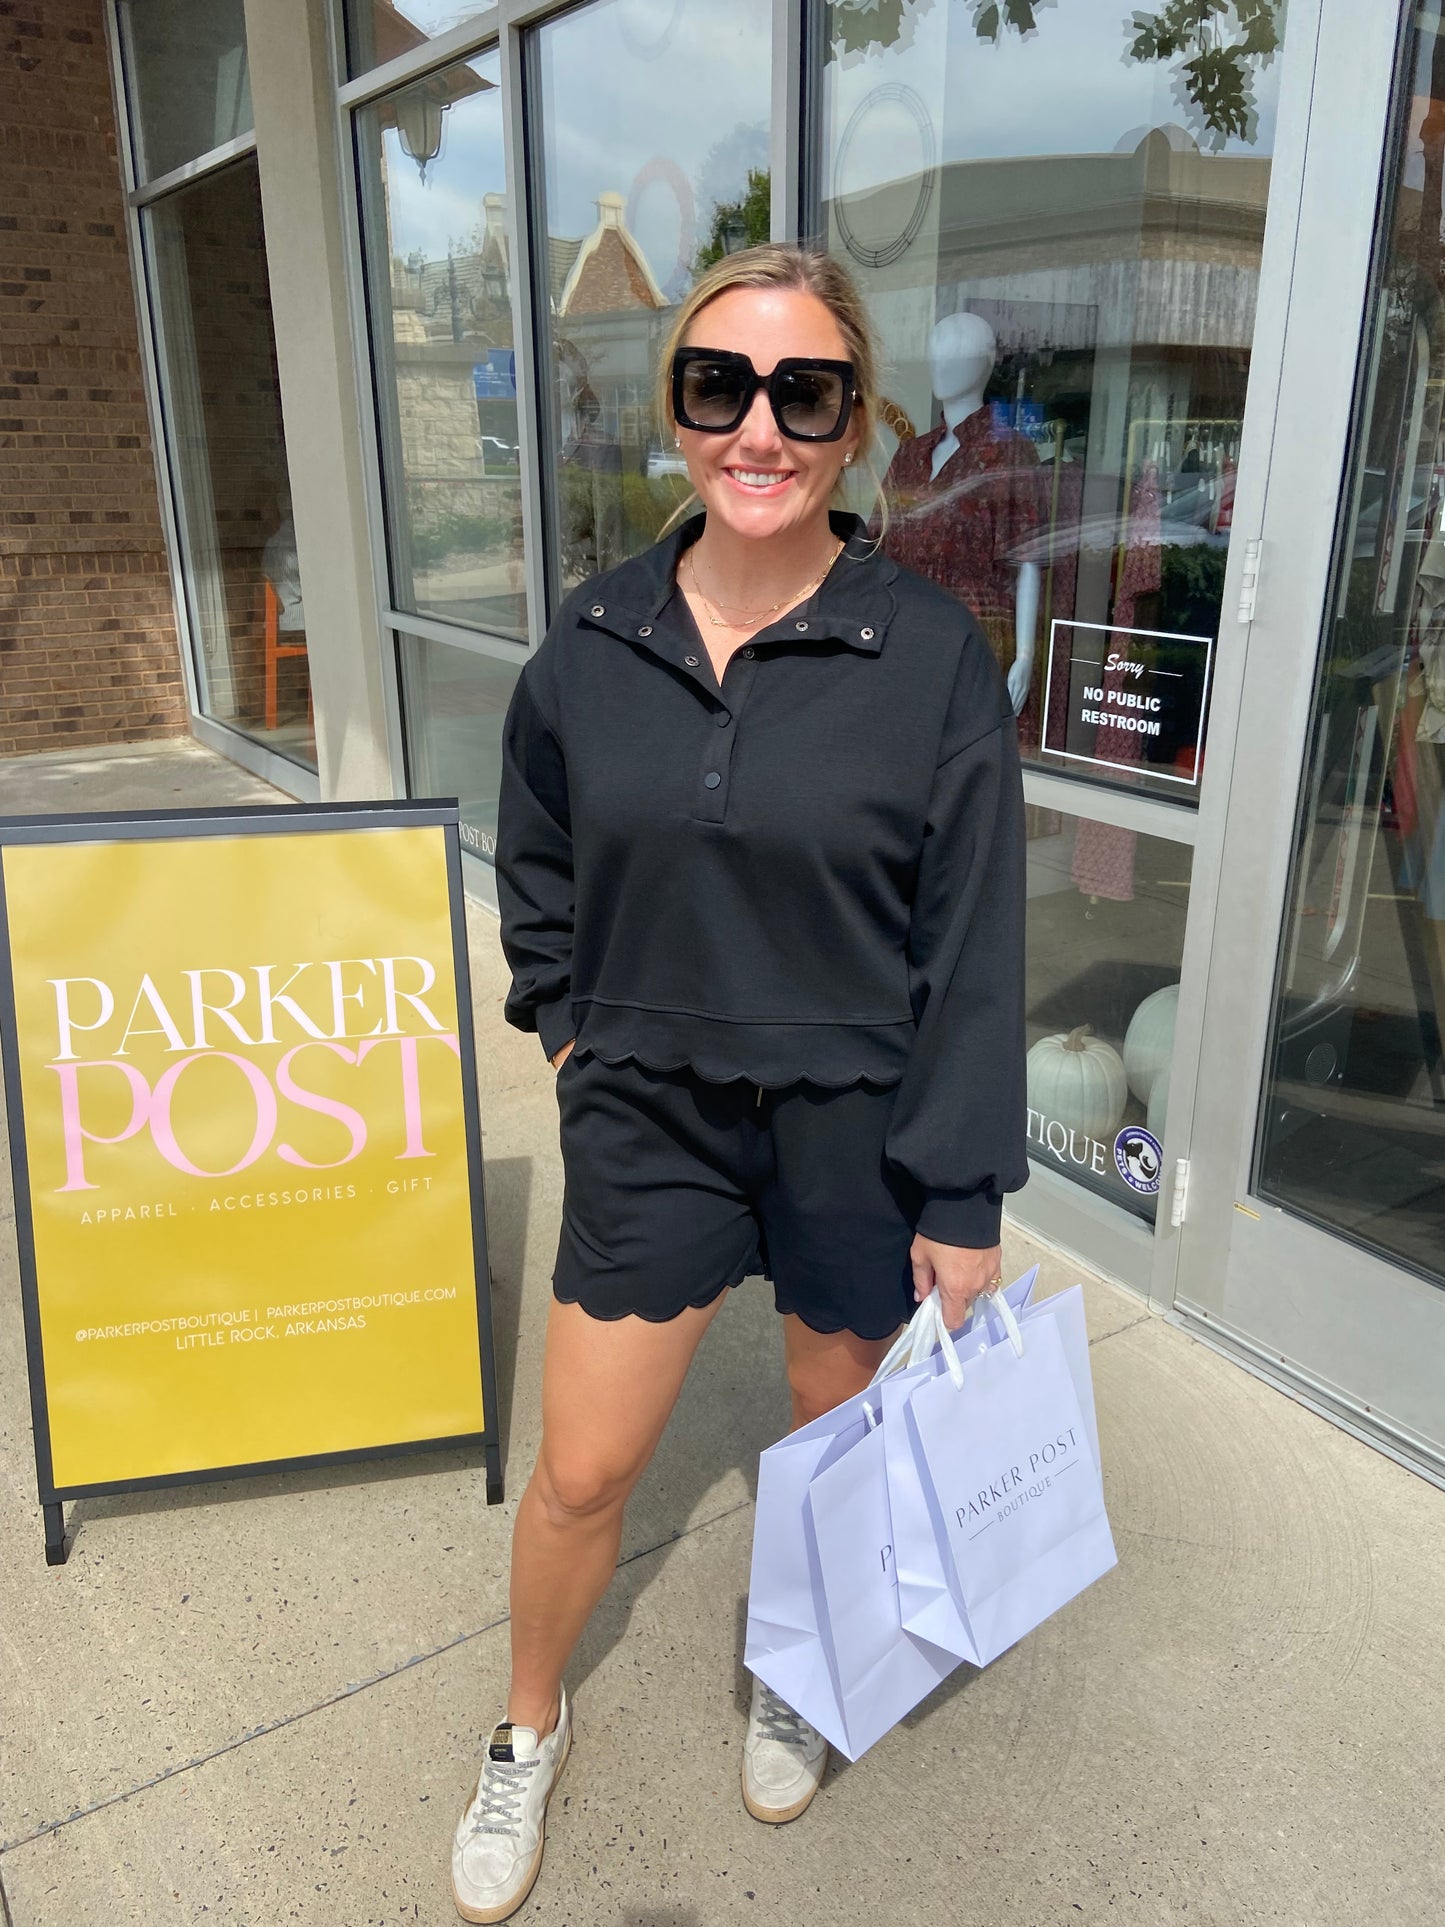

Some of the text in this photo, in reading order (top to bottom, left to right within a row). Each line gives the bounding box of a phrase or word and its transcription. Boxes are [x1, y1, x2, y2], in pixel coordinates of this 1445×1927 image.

[1104, 653, 1146, 679] Sorry
[1081, 708, 1161, 736] RESTROOM
[1083, 686, 1161, 712] NO PUBLIC
[46, 956, 449, 1061] PARKER
[44, 1034, 461, 1193] POST
[1026, 1108, 1107, 1176] TIQUE
[80, 1177, 434, 1225] APPAREL ACCESSORIES GIFT
[75, 1287, 457, 1343] @PARKERPOSTBOUTIQUE PARKERPOSTBOUTIQUE.COM
[175, 1332, 225, 1350] LITTLE
[285, 1315, 367, 1337] ARKANSAS
[955, 1428, 1079, 1529] PARKER POST
[997, 1476, 1052, 1523] BOUTIQUE
